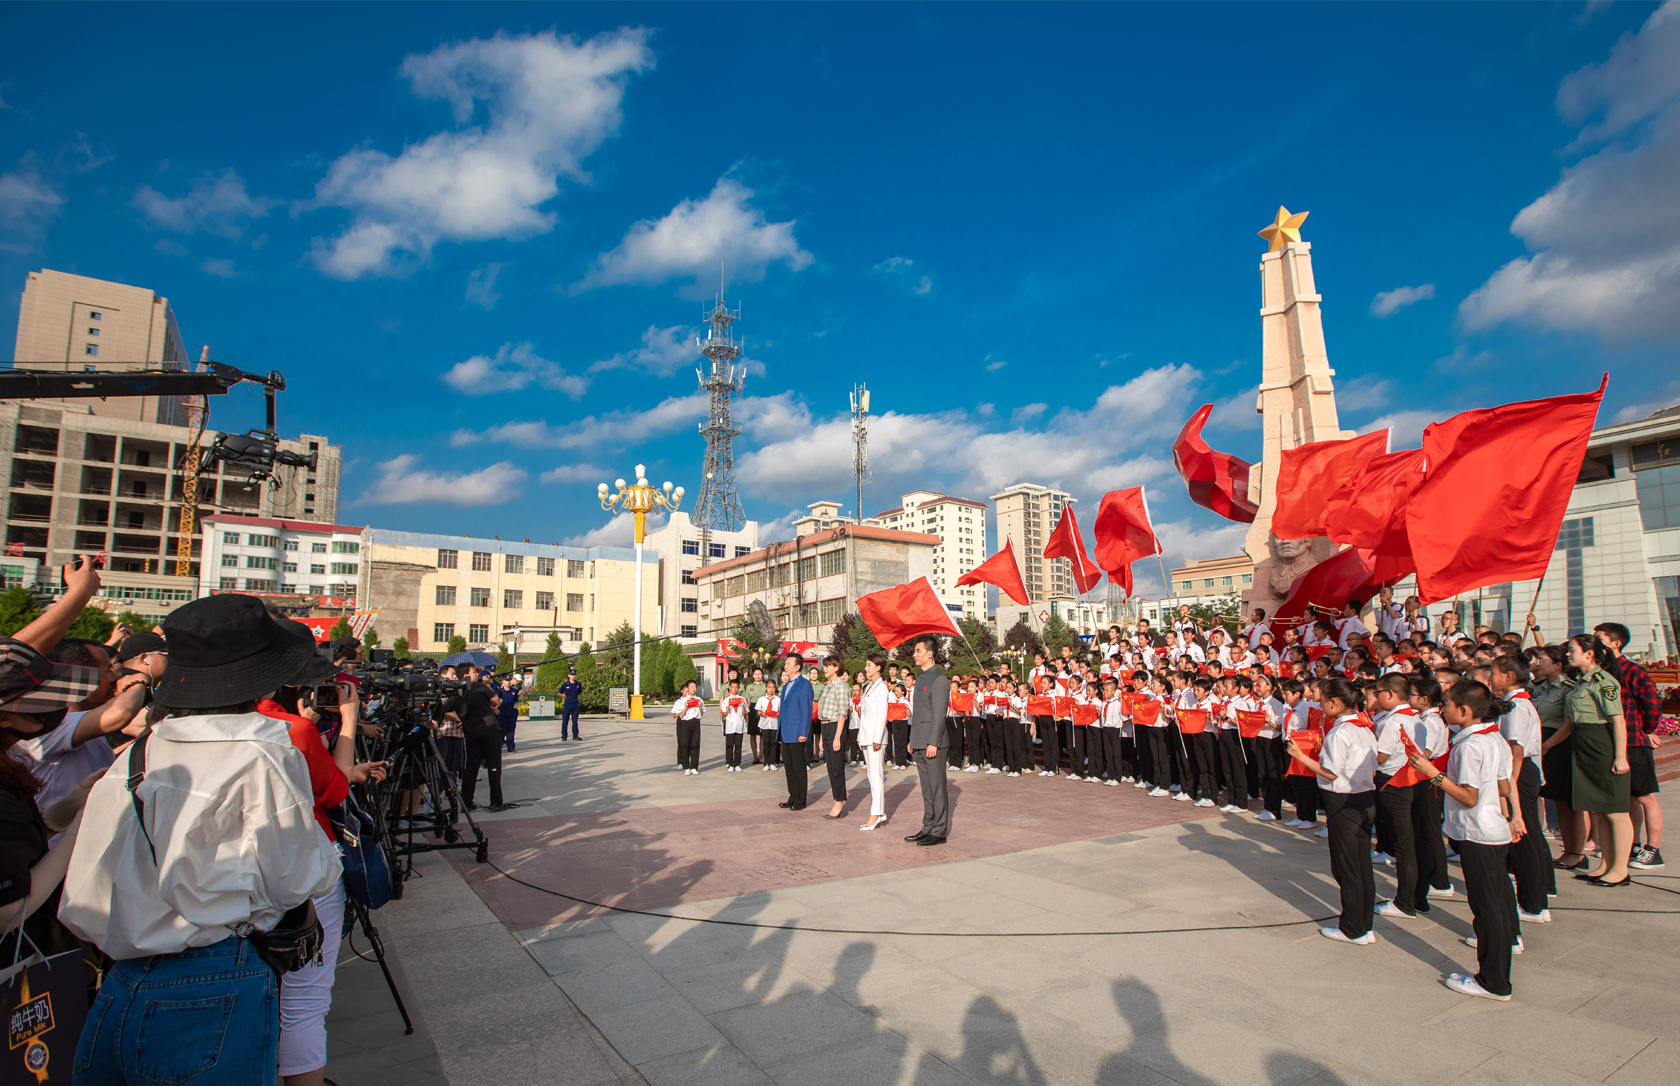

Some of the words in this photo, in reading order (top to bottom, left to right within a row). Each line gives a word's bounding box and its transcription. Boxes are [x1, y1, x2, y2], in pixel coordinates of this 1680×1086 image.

[11, 999, 49, 1035] 纯牛奶
[16, 1029, 32, 1042] Pure
